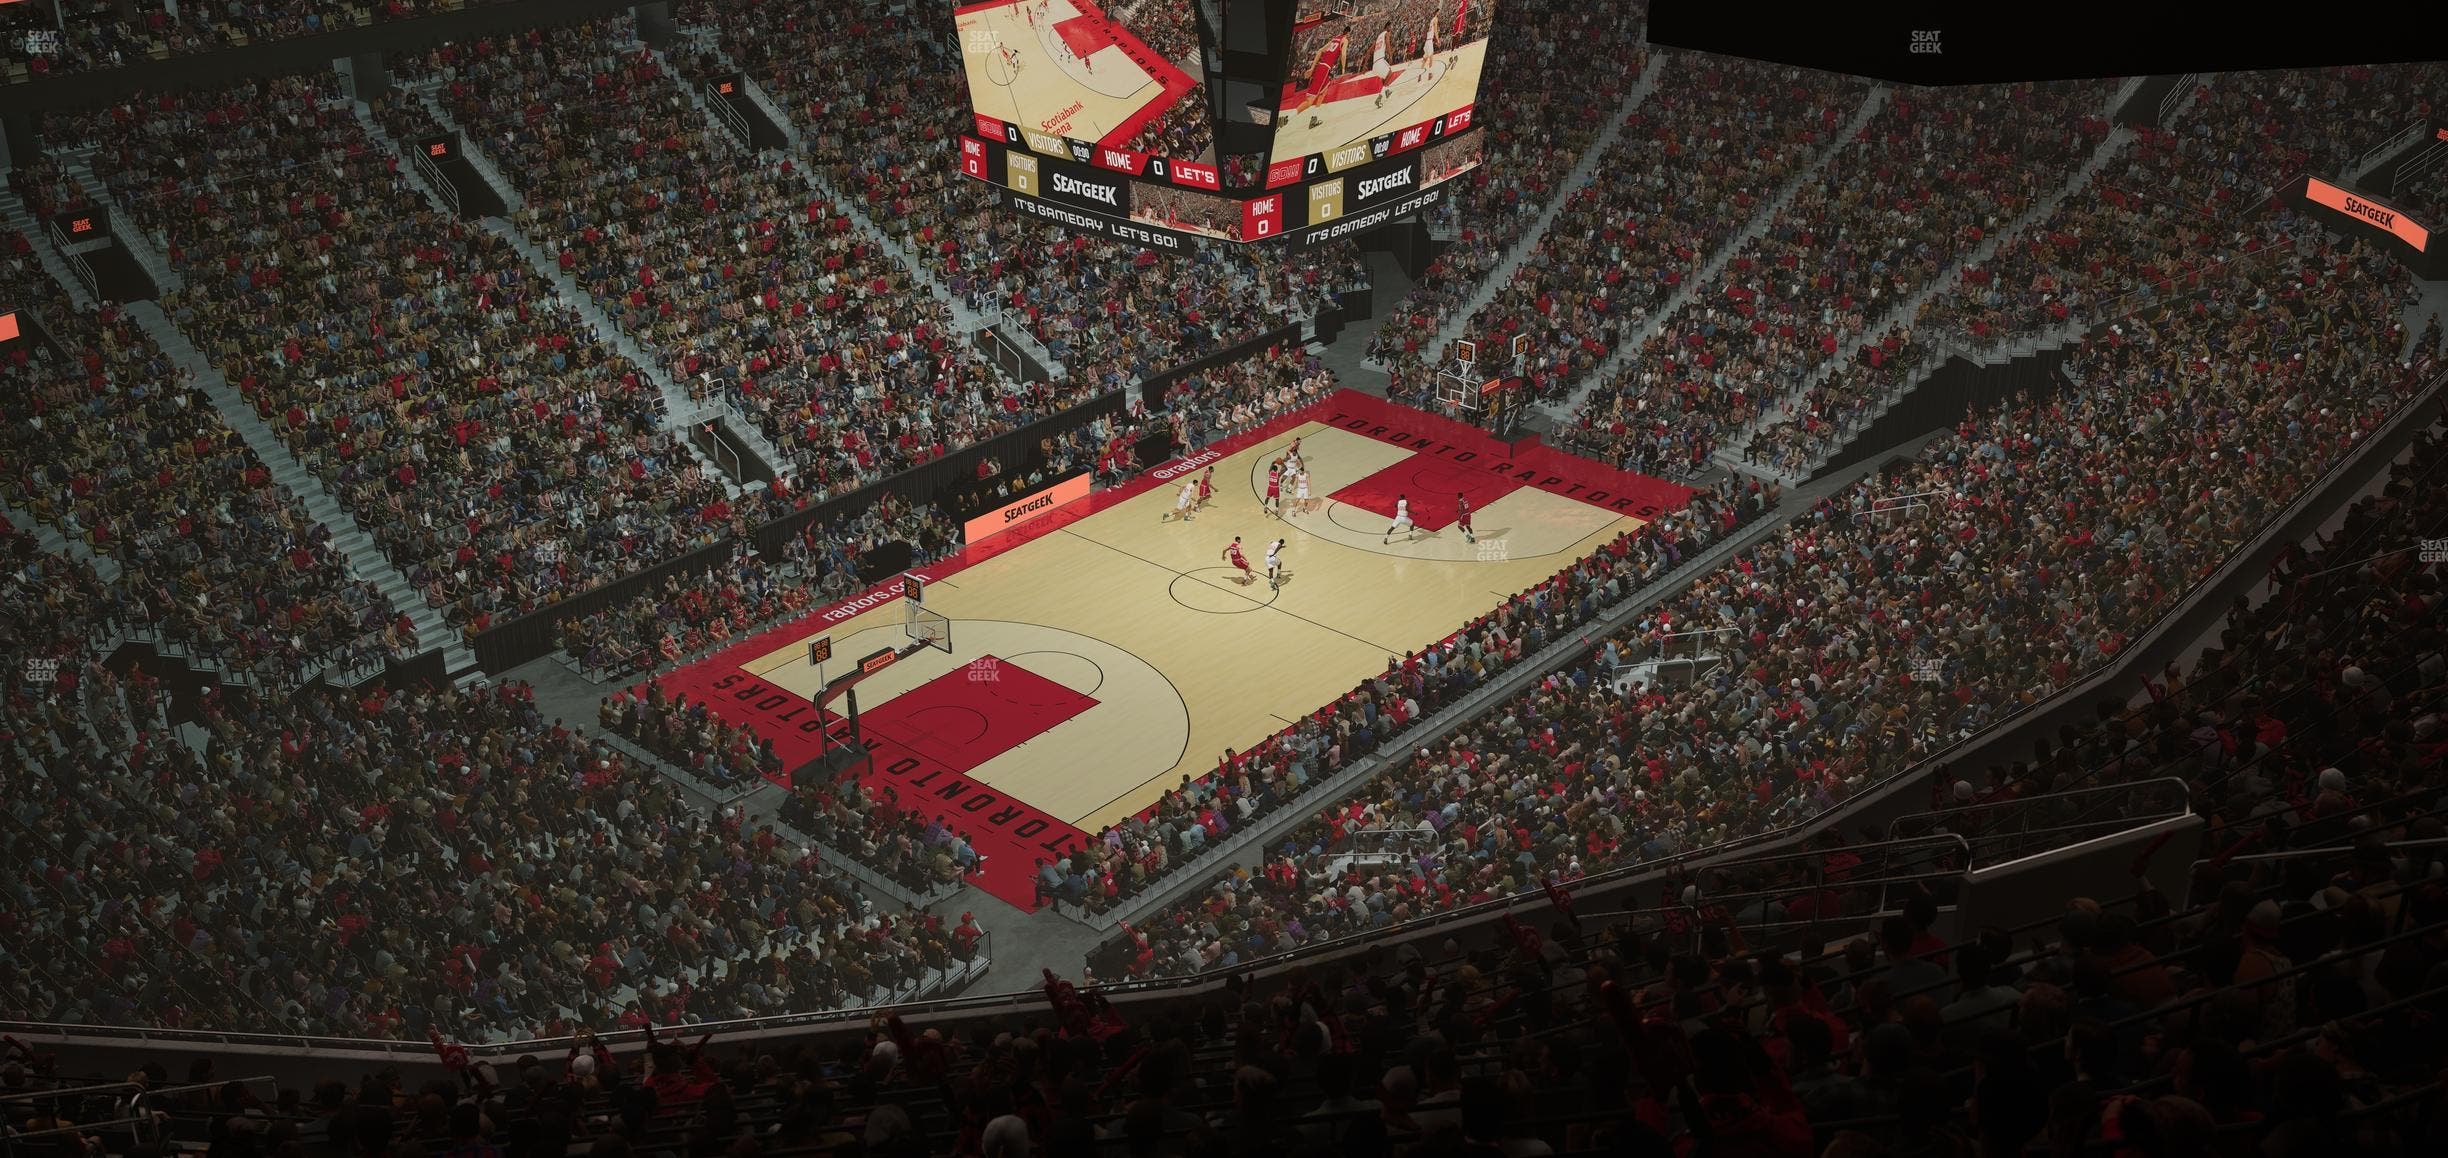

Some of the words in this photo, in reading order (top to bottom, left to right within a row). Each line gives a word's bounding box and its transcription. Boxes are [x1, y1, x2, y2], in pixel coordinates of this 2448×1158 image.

[1041, 100, 1084, 132] Scotiabank
[1052, 121, 1073, 135] rena
[1448, 110, 1471, 129] LET'S
[964, 139, 980, 157] HOME
[1028, 132, 1064, 155] VISITORS
[1400, 127, 1422, 148] HOME
[1008, 153, 1036, 173] VISITORS
[1105, 150, 1132, 170] HOME
[1331, 145, 1367, 169] VISITORS
[1175, 166, 1215, 183] LET'S
[1358, 165, 1412, 200] SEATGEEK
[1053, 173, 1117, 206] SEATGEEK
[1311, 181, 1342, 201] VISITORS
[1252, 198, 1274, 216] HOME
[1306, 229, 1329, 245] IT'S
[1331, 208, 1390, 237] GAMEDAY
[1395, 198, 1422, 216] LET'S
[1422, 190, 1440, 205] GO!
[2344, 197, 2395, 229] SEATGEEK
[1014, 197, 1036, 213] IT'S
[1037, 204, 1104, 231] GAMEDAY
[1111, 224, 1150, 242] LET'S
[1152, 233, 1178, 248] GO!
[1152, 449, 1221, 479] @raptors
[1328, 413, 1477, 462] TORONTO
[1490, 462, 1659, 517] RAPTORS
[1004, 492, 1054, 523] SEATGEEK
[886, 757, 1073, 851] TORONTO
